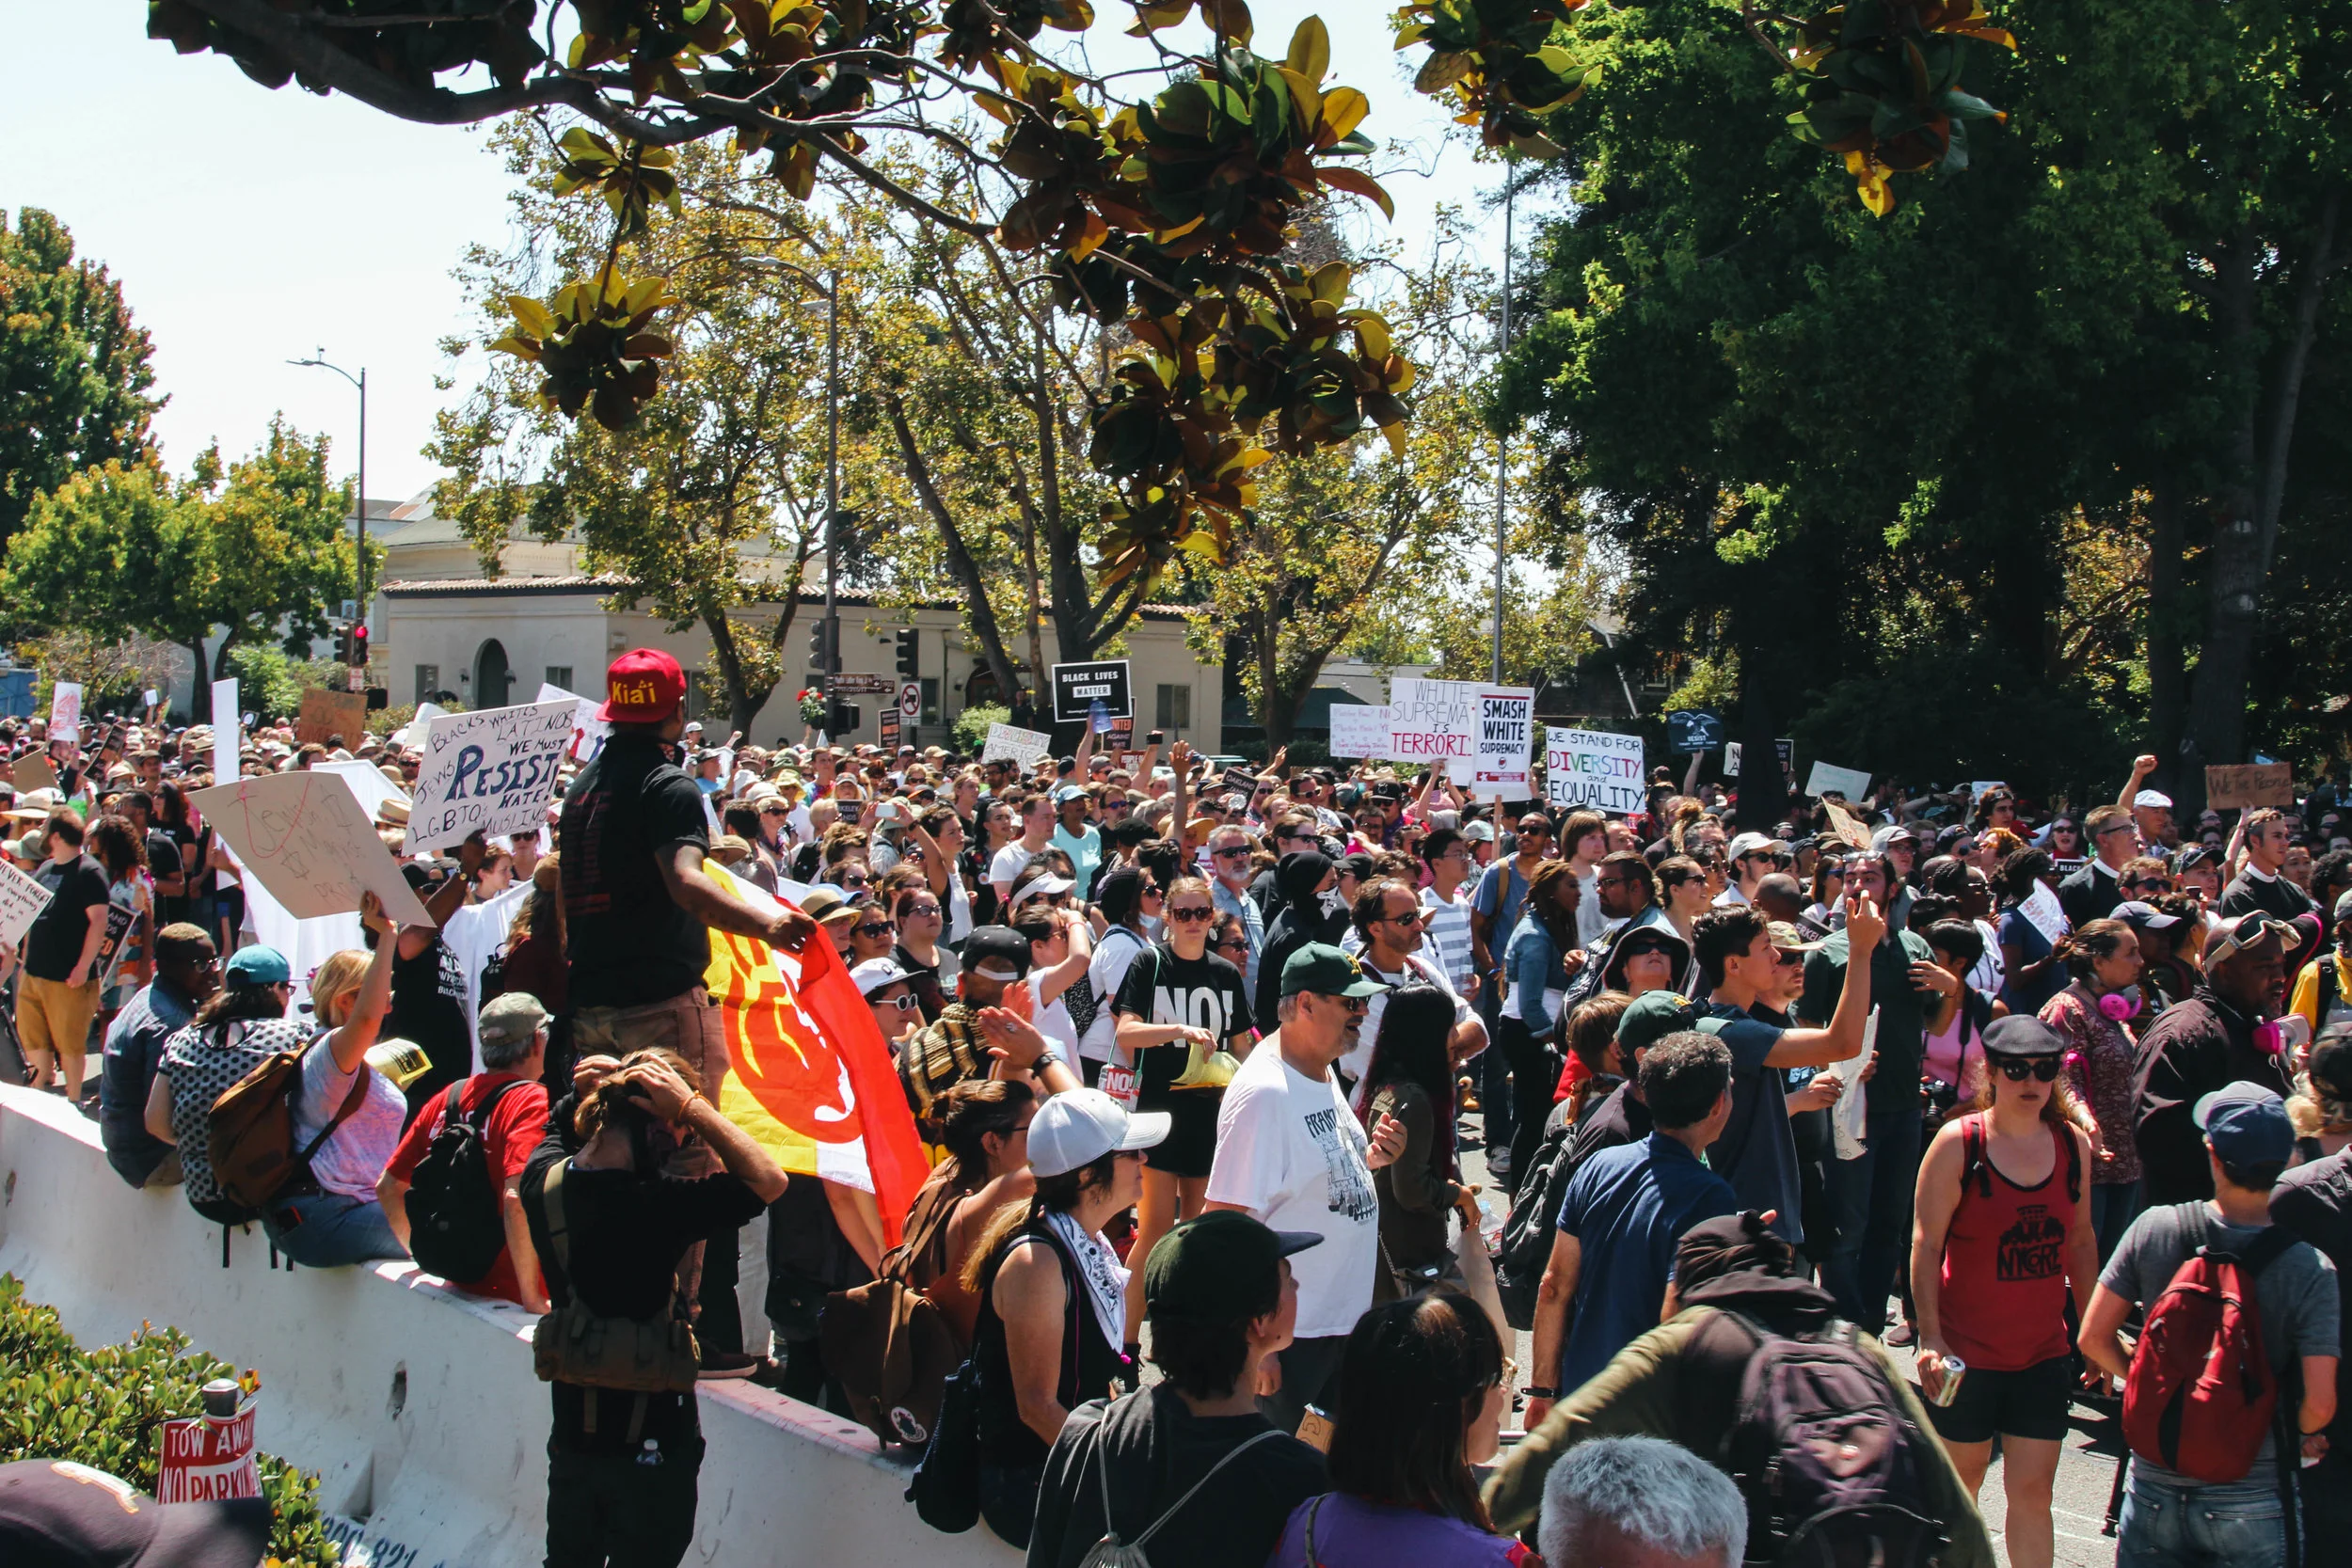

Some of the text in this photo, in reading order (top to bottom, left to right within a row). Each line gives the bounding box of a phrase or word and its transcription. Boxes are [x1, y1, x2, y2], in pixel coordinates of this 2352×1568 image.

[1062, 671, 1119, 683] BLACK LIVES
[1076, 686, 1108, 696] MATTER
[1415, 680, 1470, 705] WHITE
[1392, 700, 1470, 725] SUPREMA
[1484, 699, 1526, 720] SMASH
[431, 714, 485, 754] BLACKS
[489, 705, 538, 729] WHITES
[497, 709, 576, 741] LATINOS
[1112, 719, 1132, 731] NITED
[1433, 723, 1450, 734] IS
[1484, 721, 1525, 741] WHITE
[510, 738, 567, 756] WE MUST
[1391, 732, 1472, 757] TERRORI
[1480, 742, 1525, 755] SUPREMACY
[1548, 731, 1642, 752] WE STAND FOR
[1549, 750, 1642, 779] DIVERSITY
[416, 760, 455, 803] JEWS
[1226, 774, 1256, 791] OAKLAND
[1587, 775, 1607, 784] and
[1550, 780, 1645, 811] EQUALITY
[1152, 986, 1233, 1050] NO!
[1105, 1071, 1135, 1093] NO!
[170, 1428, 205, 1458] TOW
[162, 1467, 185, 1505] NO
